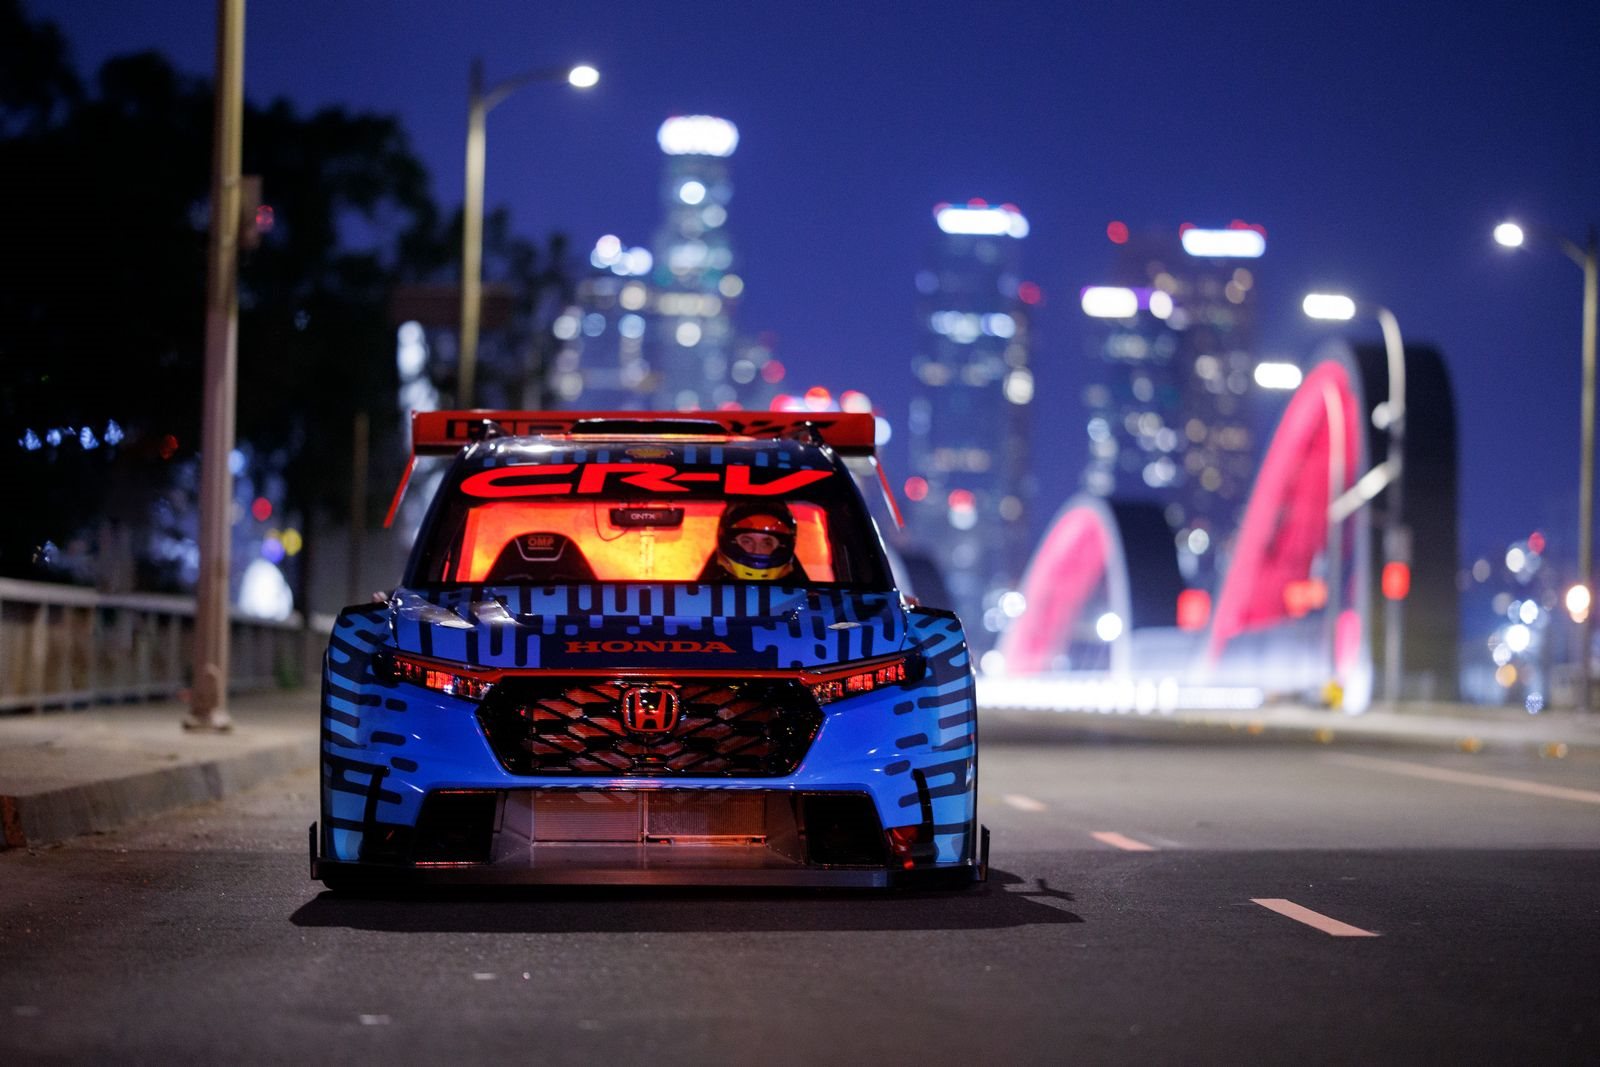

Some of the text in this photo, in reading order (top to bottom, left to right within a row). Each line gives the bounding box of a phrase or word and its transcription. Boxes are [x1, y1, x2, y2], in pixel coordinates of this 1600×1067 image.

[460, 463, 834, 498] CR-V
[527, 536, 554, 548] OMP
[565, 640, 737, 653] HONDA
